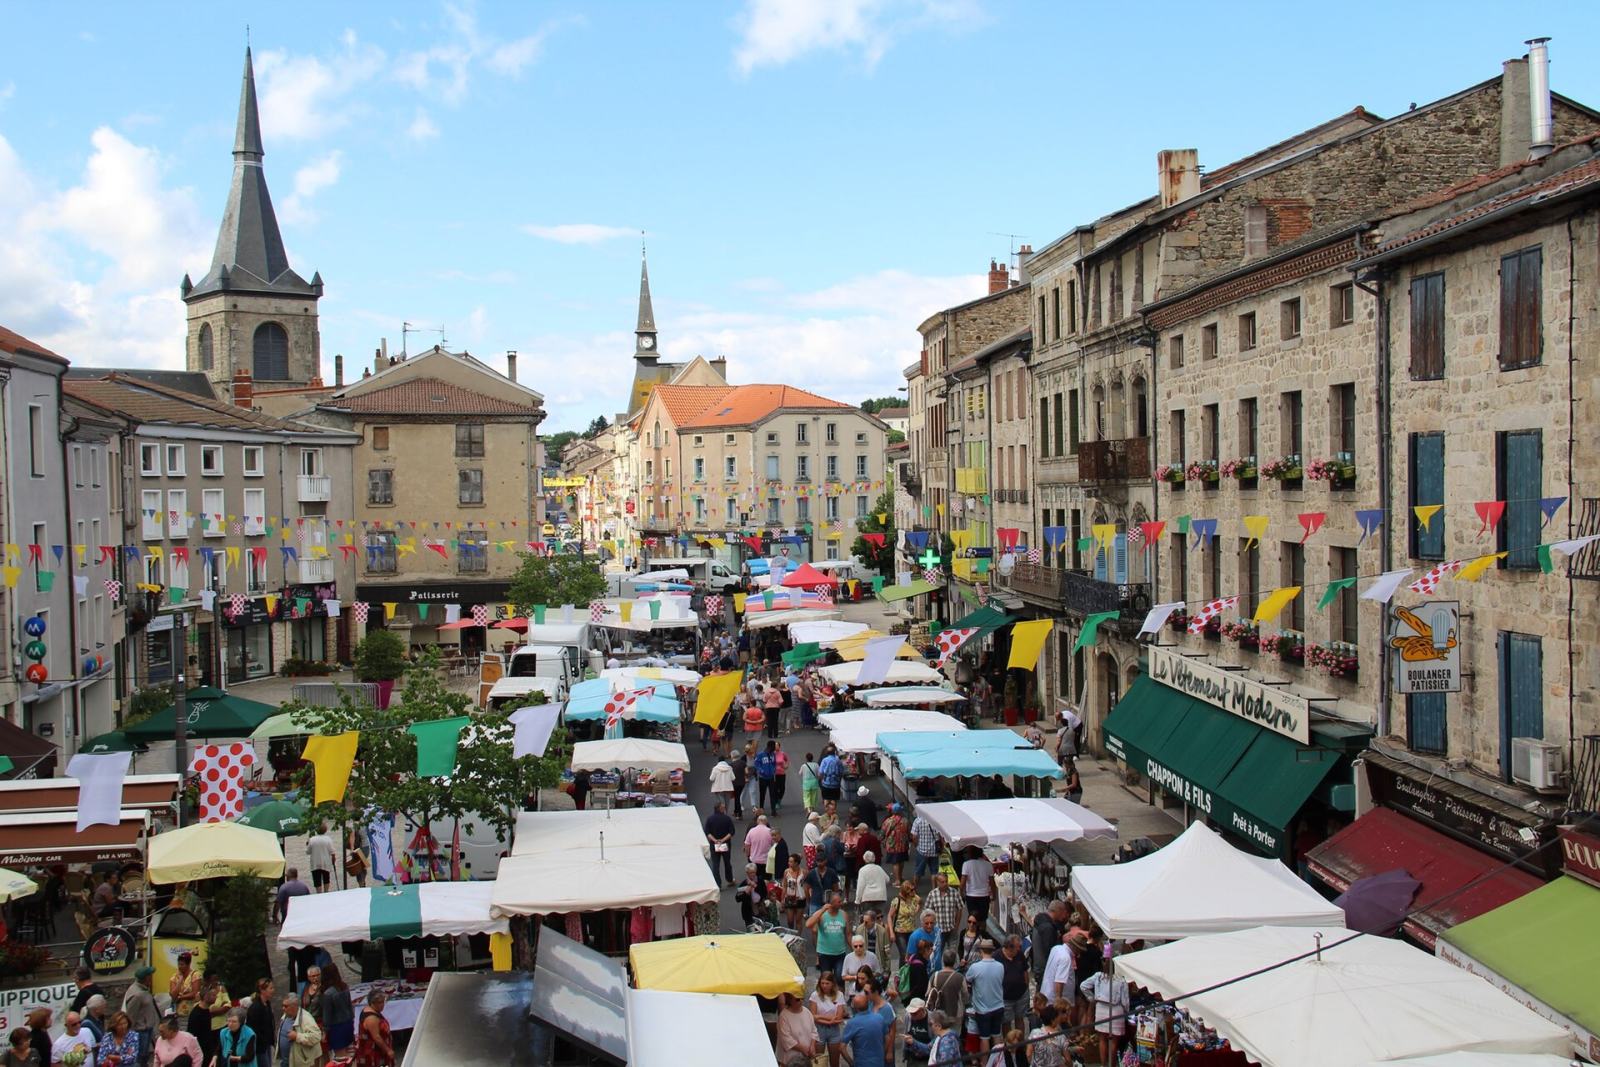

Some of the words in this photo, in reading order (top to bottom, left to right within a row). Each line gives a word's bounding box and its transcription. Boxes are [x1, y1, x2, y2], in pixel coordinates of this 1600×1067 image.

[409, 591, 460, 600] Patisserie
[1408, 669, 1451, 680] BOULANGER
[1411, 680, 1449, 690] PATISSIER
[1153, 651, 1167, 679] Le
[1168, 656, 1231, 708] Vêtement
[1232, 680, 1298, 733] Modern
[1147, 759, 1183, 796] CHAPPON
[1184, 780, 1191, 801] &
[1192, 784, 1212, 814] FILS
[1396, 776, 1436, 803] Boulangerie
[1445, 797, 1484, 825] Pâtisserie
[1232, 811, 1247, 832] Prêt
[1247, 822, 1252, 834] à
[1253, 824, 1276, 849] Porter
[1, 854, 43, 864] Madison
